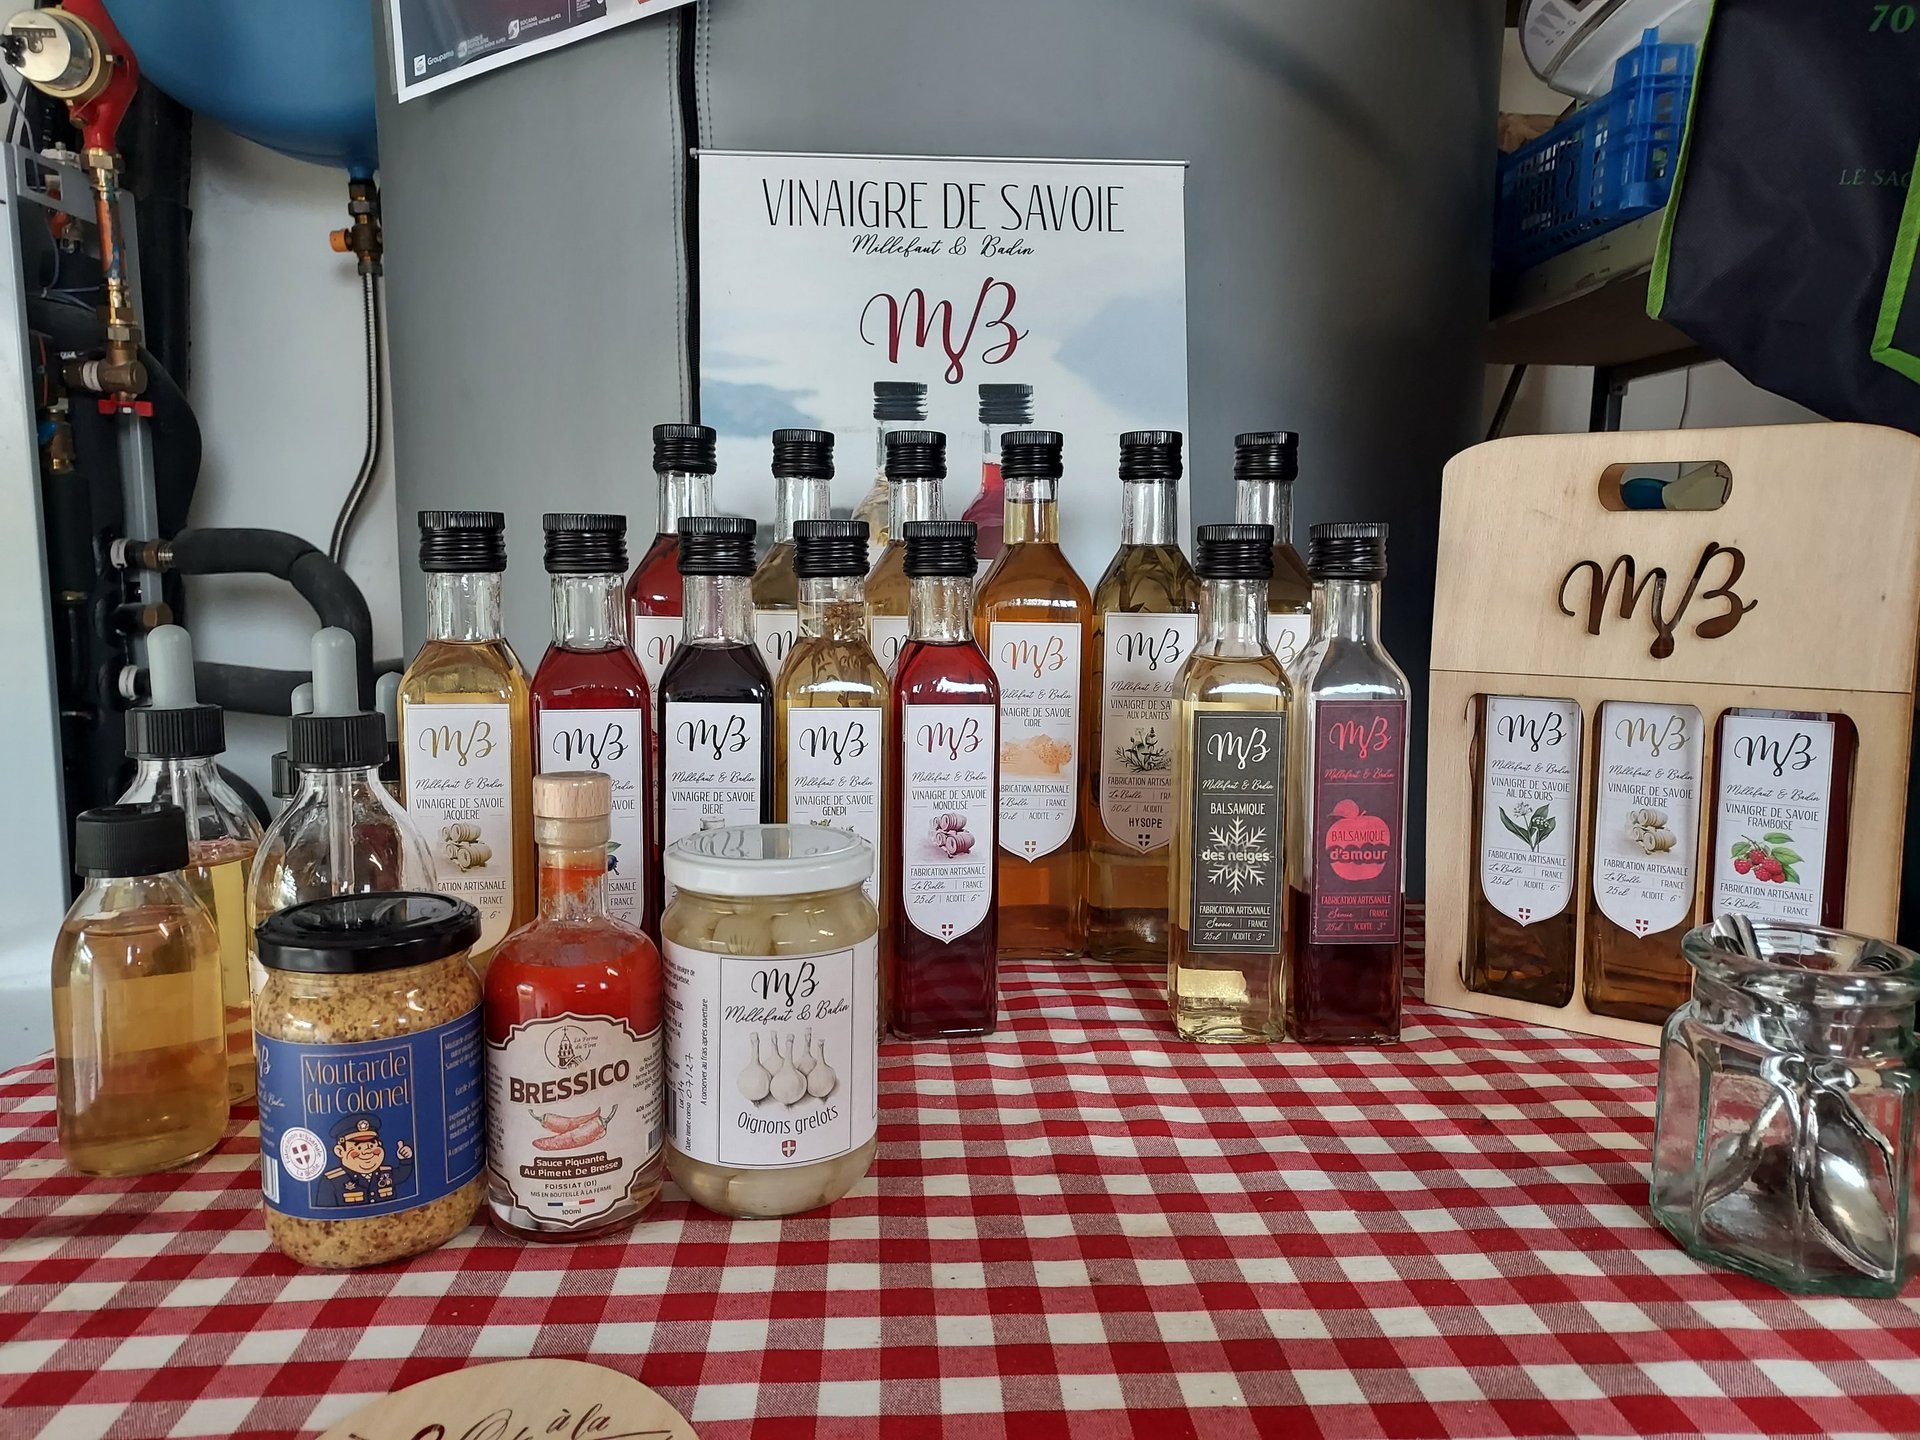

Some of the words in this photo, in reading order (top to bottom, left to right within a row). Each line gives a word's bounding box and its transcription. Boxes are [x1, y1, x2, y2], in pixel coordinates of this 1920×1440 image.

[1868, 4, 1915, 33] 70
[427, 50, 454, 66] Groupama
[1839, 168, 1866, 186] LE
[763, 178, 929, 229] VINAIGRE
[944, 182, 988, 230] DE
[1000, 184, 1125, 232] SAVOIE
[853, 233, 943, 259] Millefaut
[949, 236, 968, 256] &
[981, 234, 1036, 258] Badin
[1558, 541, 1758, 659] MB
[1111, 699, 1145, 710] VINAIGRE
[1148, 700, 1157, 710] DE
[1000, 707, 1031, 718] INAIGRE
[1033, 707, 1043, 717] DE
[1045, 707, 1071, 718] SAVOIE
[1126, 710, 1139, 720] AUX
[1140, 710, 1169, 721] PLANTES
[1023, 718, 1042, 727] CIDRE
[1534, 762, 1543, 772] &
[1655, 768, 1664, 778] &
[718, 771, 727, 783] &
[839, 776, 848, 787] &
[1108, 776, 1146, 786] FABRICATION
[464, 777, 474, 790] &
[1033, 784, 1070, 793] ARTISANALE
[1491, 777, 1527, 789] VINAIGRE
[1529, 780, 1540, 790] DE
[1542, 780, 1570, 793] SAVOIE
[671, 791, 710, 802] VINAIGRE
[713, 791, 724, 802] DE
[727, 791, 756, 802] SAVOIE
[912, 789, 947, 800] VINAIGRE
[949, 789, 959, 800] DE
[961, 789, 987, 800] SAVOIE
[1505, 789, 1517, 798] AIL
[1518, 789, 1532, 800] DES
[1534, 790, 1553, 801] OURS
[1608, 782, 1646, 796] VINAIGRE
[1649, 786, 1660, 797] DE
[1662, 787, 1693, 800] SAVOIE
[1777, 788, 1787, 798] &
[415, 797, 457, 810] VINAIGRE
[459, 797, 471, 810] DE
[474, 796, 505, 810] SAVOIE
[795, 795, 832, 806] VINAIGRE
[833, 795, 844, 806] DE
[847, 795, 874, 806] SAVOIE
[932, 800, 969, 811] MONDEUSE
[1045, 799, 1067, 807] FRANCE
[1632, 795, 1668, 808] JACQUERE
[702, 803, 724, 815] BIERE
[822, 806, 847, 817] GENEPI
[1210, 802, 1266, 815] BALSAMIQUE
[1725, 803, 1768, 817] VINAIGRE
[1771, 807, 1782, 819] DE
[1786, 808, 1819, 822] SAVOIE
[443, 809, 480, 821] JACQUERE
[1128, 817, 1163, 828] HYSOPE
[1747, 817, 1793, 831] FRAMBOISE
[1330, 830, 1385, 842] BALSAMIQUE
[1201, 849, 1225, 862] des
[1227, 850, 1270, 864] neiges
[1329, 848, 1387, 861] d'amour
[1488, 849, 1527, 863] FABRICATION
[1528, 854, 1566, 867] ARTISANALE
[910, 867, 949, 877] FABRICATION
[949, 866, 986, 876] ARTISANALE
[1603, 858, 1646, 871] FABRICATION
[1647, 862, 1689, 876] ARTISANALE
[1541, 869, 1564, 879] FRANCE
[463, 881, 506, 891] ARTISANALE
[962, 880, 983, 889] FRANCE
[1523, 879, 1544, 890] ACIDITE
[1660, 879, 1685, 890] FRANCE
[945, 894, 966, 903] ACIDITE
[1641, 890, 1664, 901] ACIDITE
[1720, 882, 1766, 897] FABRICATION
[1767, 889, 1813, 903] ARTISANALE
[479, 896, 503, 905] FRANCE
[610, 897, 634, 906] FRANCE
[1199, 905, 1236, 915] FABRICATION
[1236, 905, 1271, 915] ARTISANALE
[1783, 905, 1808, 917] FRANCE
[1248, 919, 1268, 929] FRANCE
[1231, 932, 1251, 941] ACIDITE
[751, 961, 820, 1007] MB
[725, 1005, 794, 1026] Millefaut
[796, 1004, 811, 1020] &
[815, 998, 850, 1020] Badin
[700, 1029, 709, 1047] après
[700, 1047, 708, 1061] frais
[304, 1052, 408, 1088] Moutarde
[701, 1061, 708, 1070] au
[509, 1059, 630, 1104] BRESSICO
[306, 1092, 331, 1115] du
[336, 1079, 410, 1113] Colonel
[737, 1111, 791, 1135] Oignons
[795, 1105, 839, 1135] grelots
[536, 1158, 563, 1168] Sauce
[565, 1154, 605, 1168] Piquante
[523, 1168, 535, 1176] Au
[538, 1168, 572, 1177] Piment
[575, 1167, 588, 1176] De
[590, 1160, 619, 1173] Bresse
[545, 1182, 581, 1190] FOISSIAT
[583, 1180, 597, 1189] (01)
[586, 1188, 593, 1196] LA
[593, 1184, 612, 1194] FERME
[561, 1208, 582, 1216] 100ml
[545, 1408, 571, 1435] à
